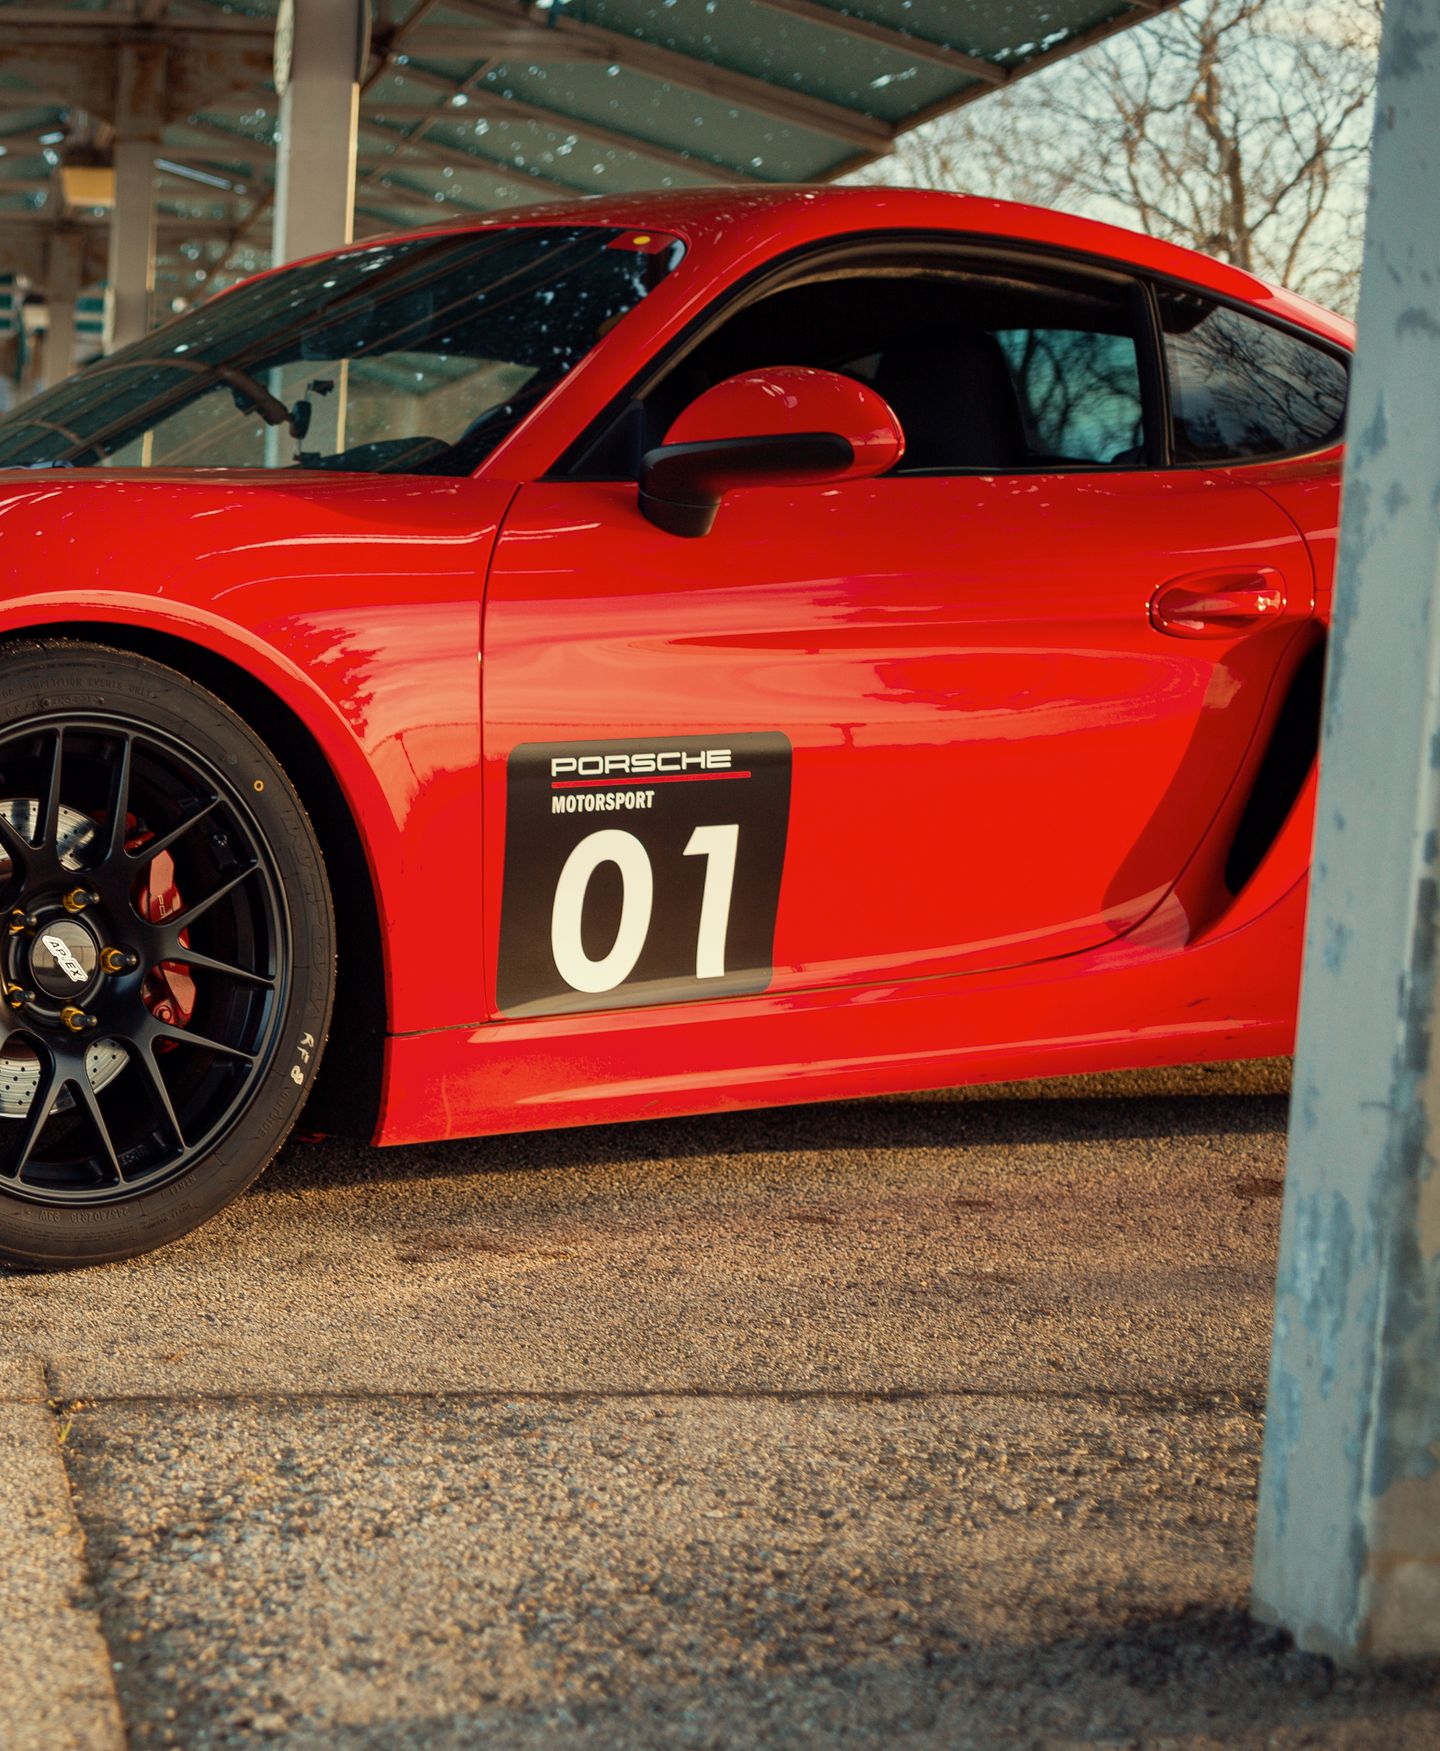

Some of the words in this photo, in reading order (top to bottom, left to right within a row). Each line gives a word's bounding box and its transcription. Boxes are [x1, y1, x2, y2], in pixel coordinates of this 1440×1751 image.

[551, 749, 732, 777] PORSCHE
[551, 790, 655, 813] MOTORSPORT
[551, 824, 740, 993] 01
[45, 938, 86, 980] APEX
